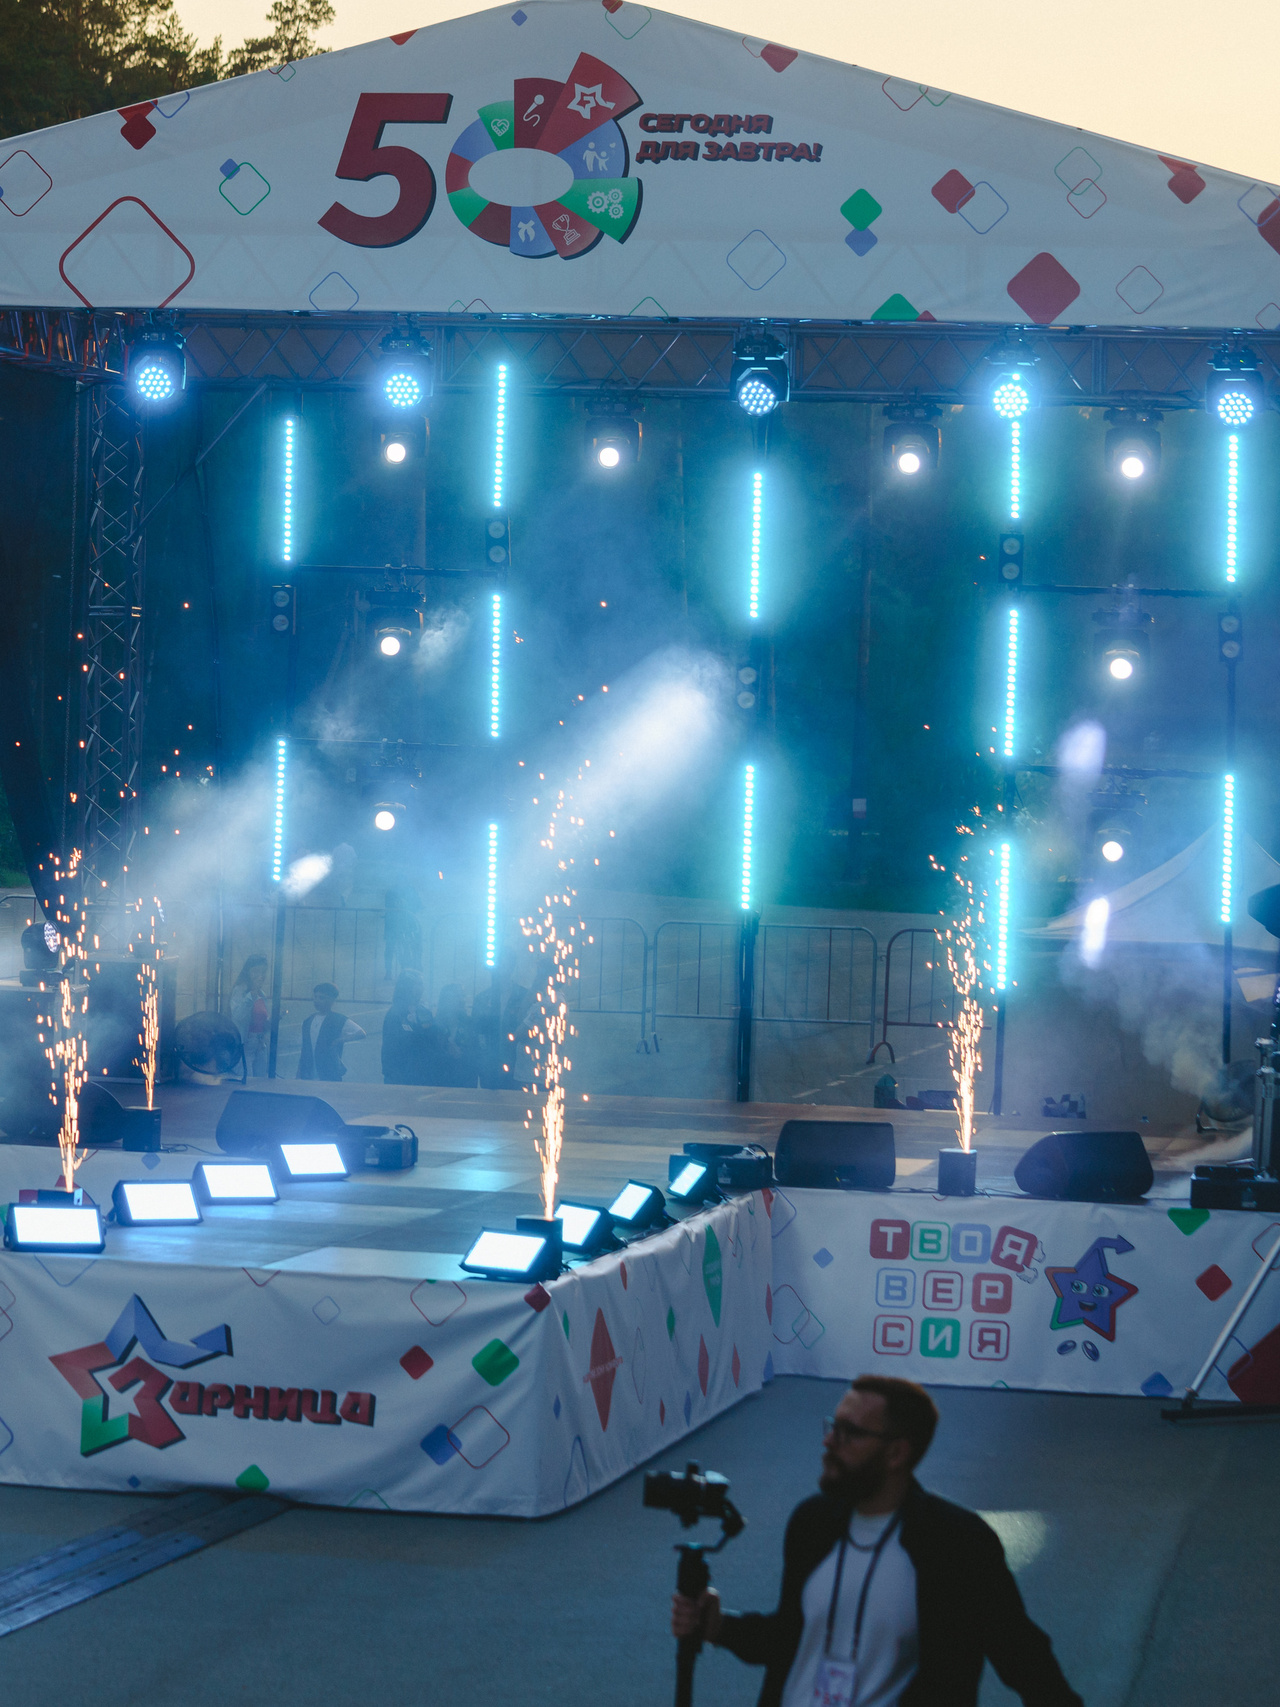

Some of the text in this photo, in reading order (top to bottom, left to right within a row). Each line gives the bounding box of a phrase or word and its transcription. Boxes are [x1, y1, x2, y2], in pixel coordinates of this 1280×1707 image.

[639, 112, 773, 137] СЕГОДНЯ
[635, 141, 823, 164] ДЛЯ ЗАВТРА!
[877, 1224, 1029, 1265] ТВОЯ
[882, 1274, 1006, 1307] ВЕР
[880, 1321, 1003, 1355] СИЯ
